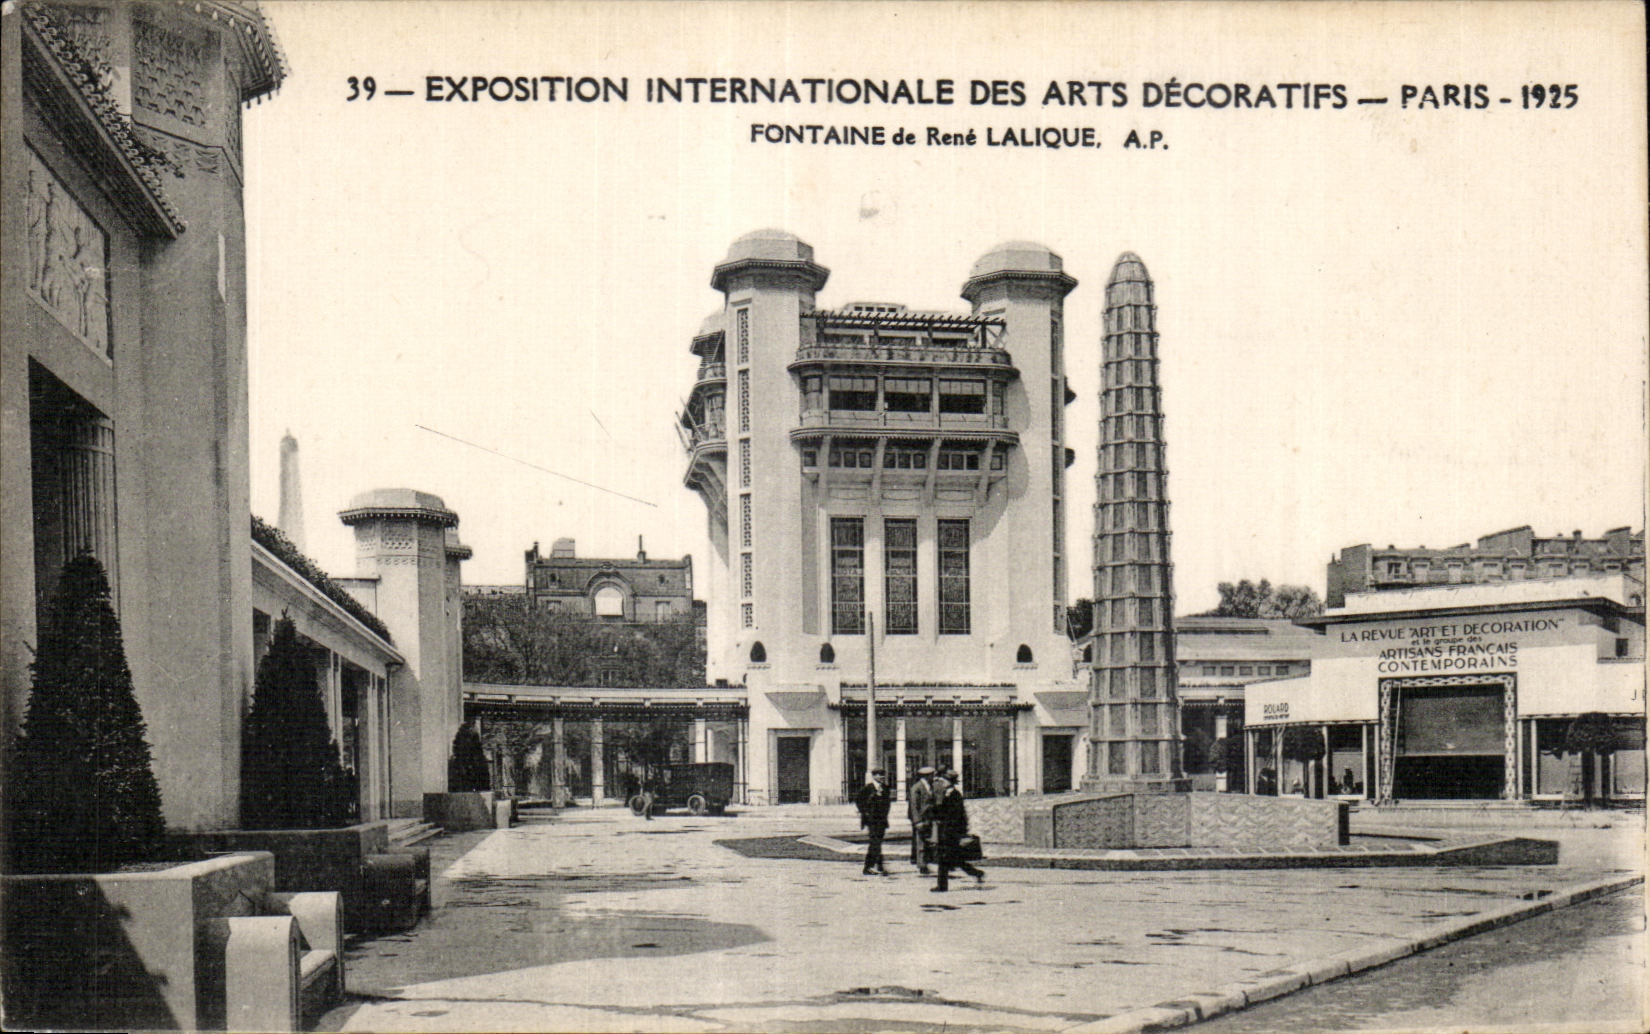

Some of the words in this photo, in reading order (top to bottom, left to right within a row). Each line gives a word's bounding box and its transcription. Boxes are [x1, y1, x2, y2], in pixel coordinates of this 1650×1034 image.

[1341, 631, 1358, 643] LA
[1361, 628, 1405, 642] REVUE
[1441, 625, 1458, 637] ET
[1379, 646, 1443, 660] ARTISANS
[1378, 655, 1517, 672] CONTEMPORAINS
